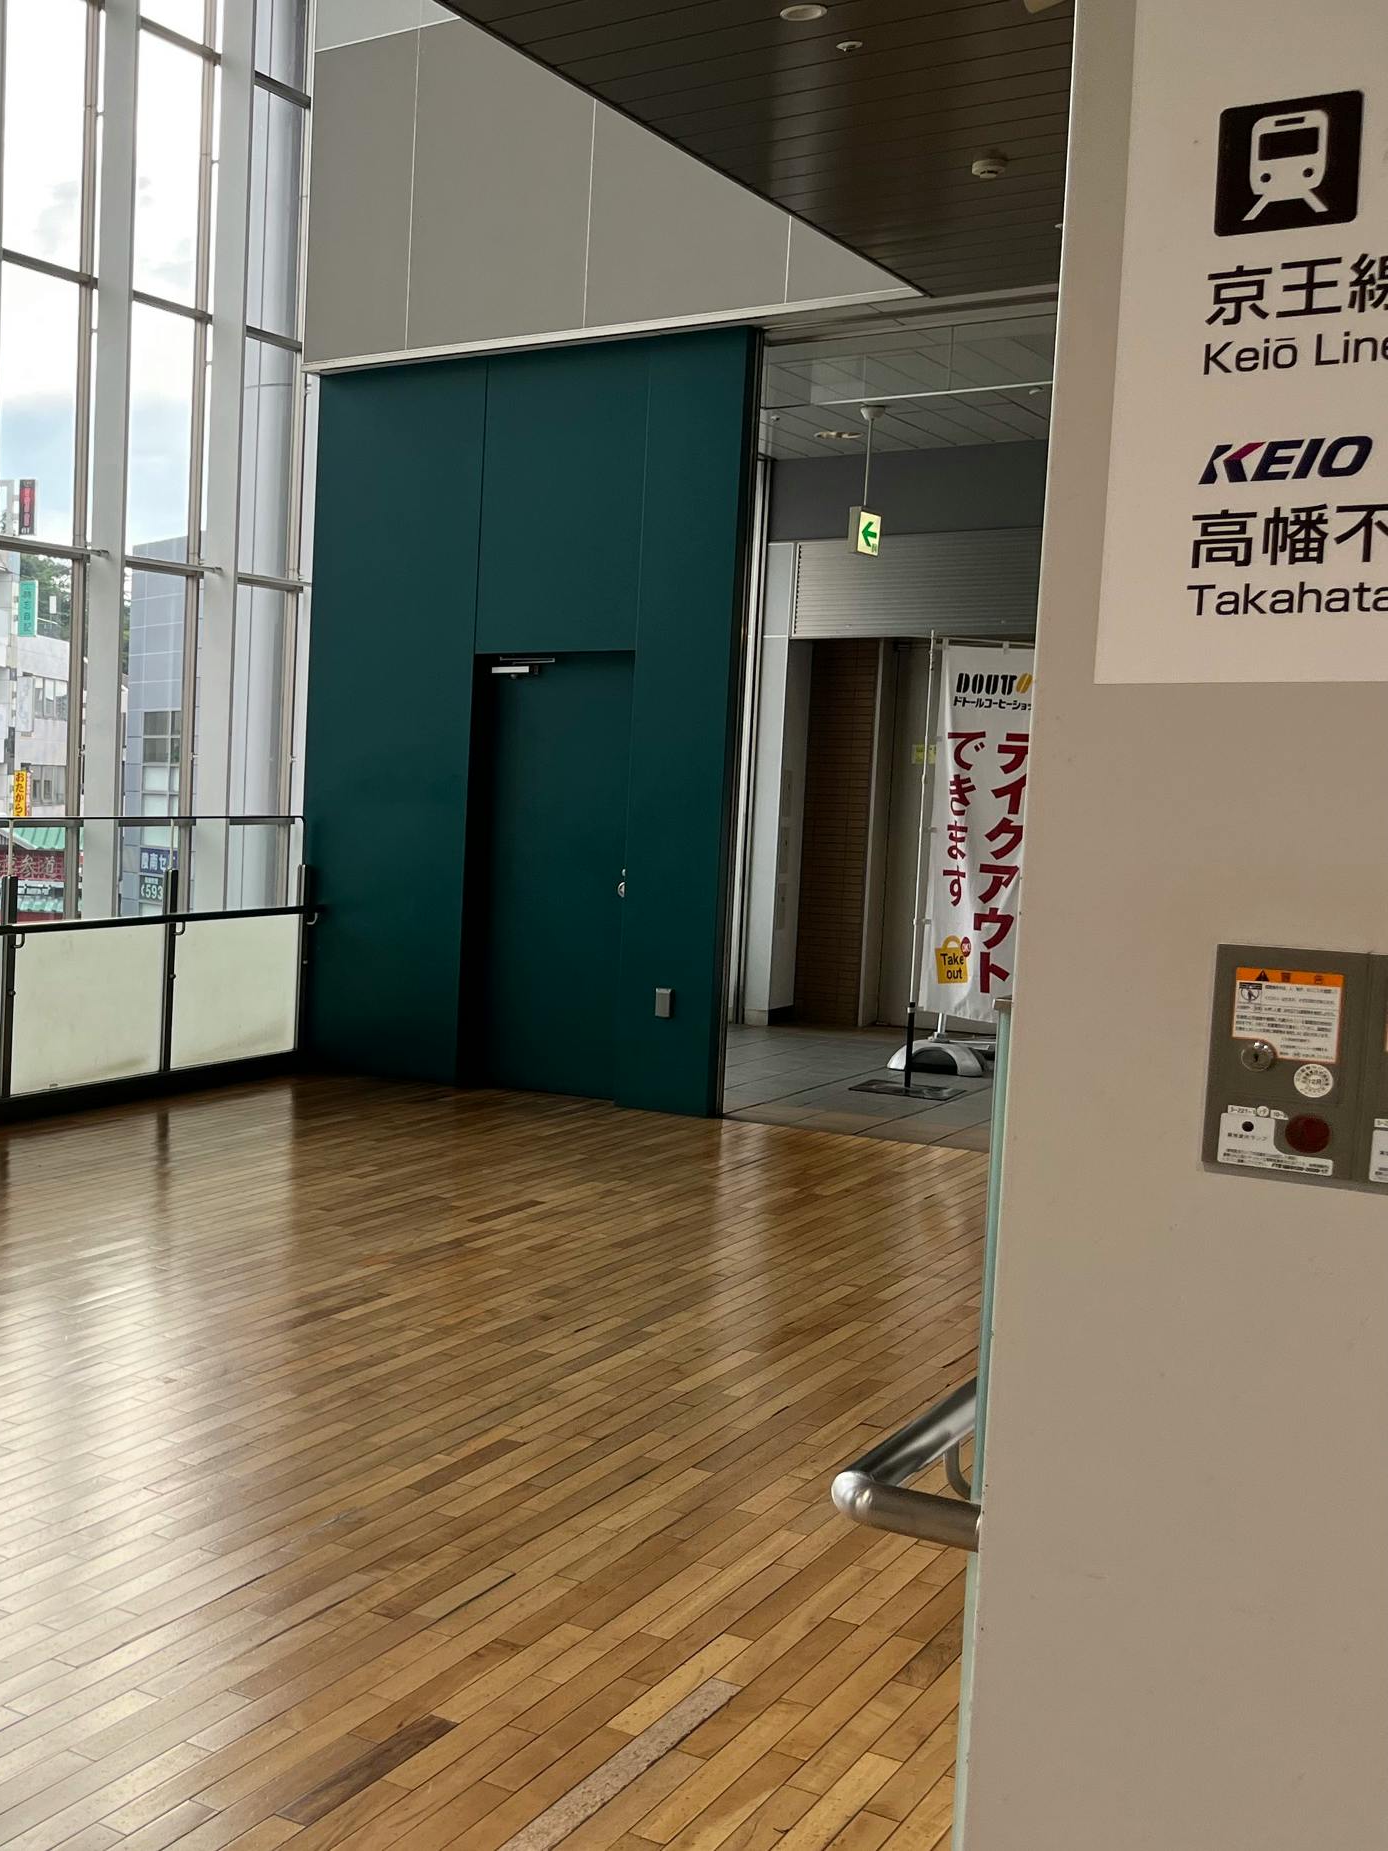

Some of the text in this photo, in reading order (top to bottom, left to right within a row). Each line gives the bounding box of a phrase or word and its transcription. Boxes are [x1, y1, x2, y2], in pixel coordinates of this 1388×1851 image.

[1198, 435, 1374, 485] KEIO
[1190, 503, 1388, 570] 高幡不
[15, 773, 24, 816] おたから
[943, 731, 986, 907] できます
[973, 733, 1029, 994] テイクアウト
[940, 953, 964, 966] Take
[946, 968, 963, 980] out
